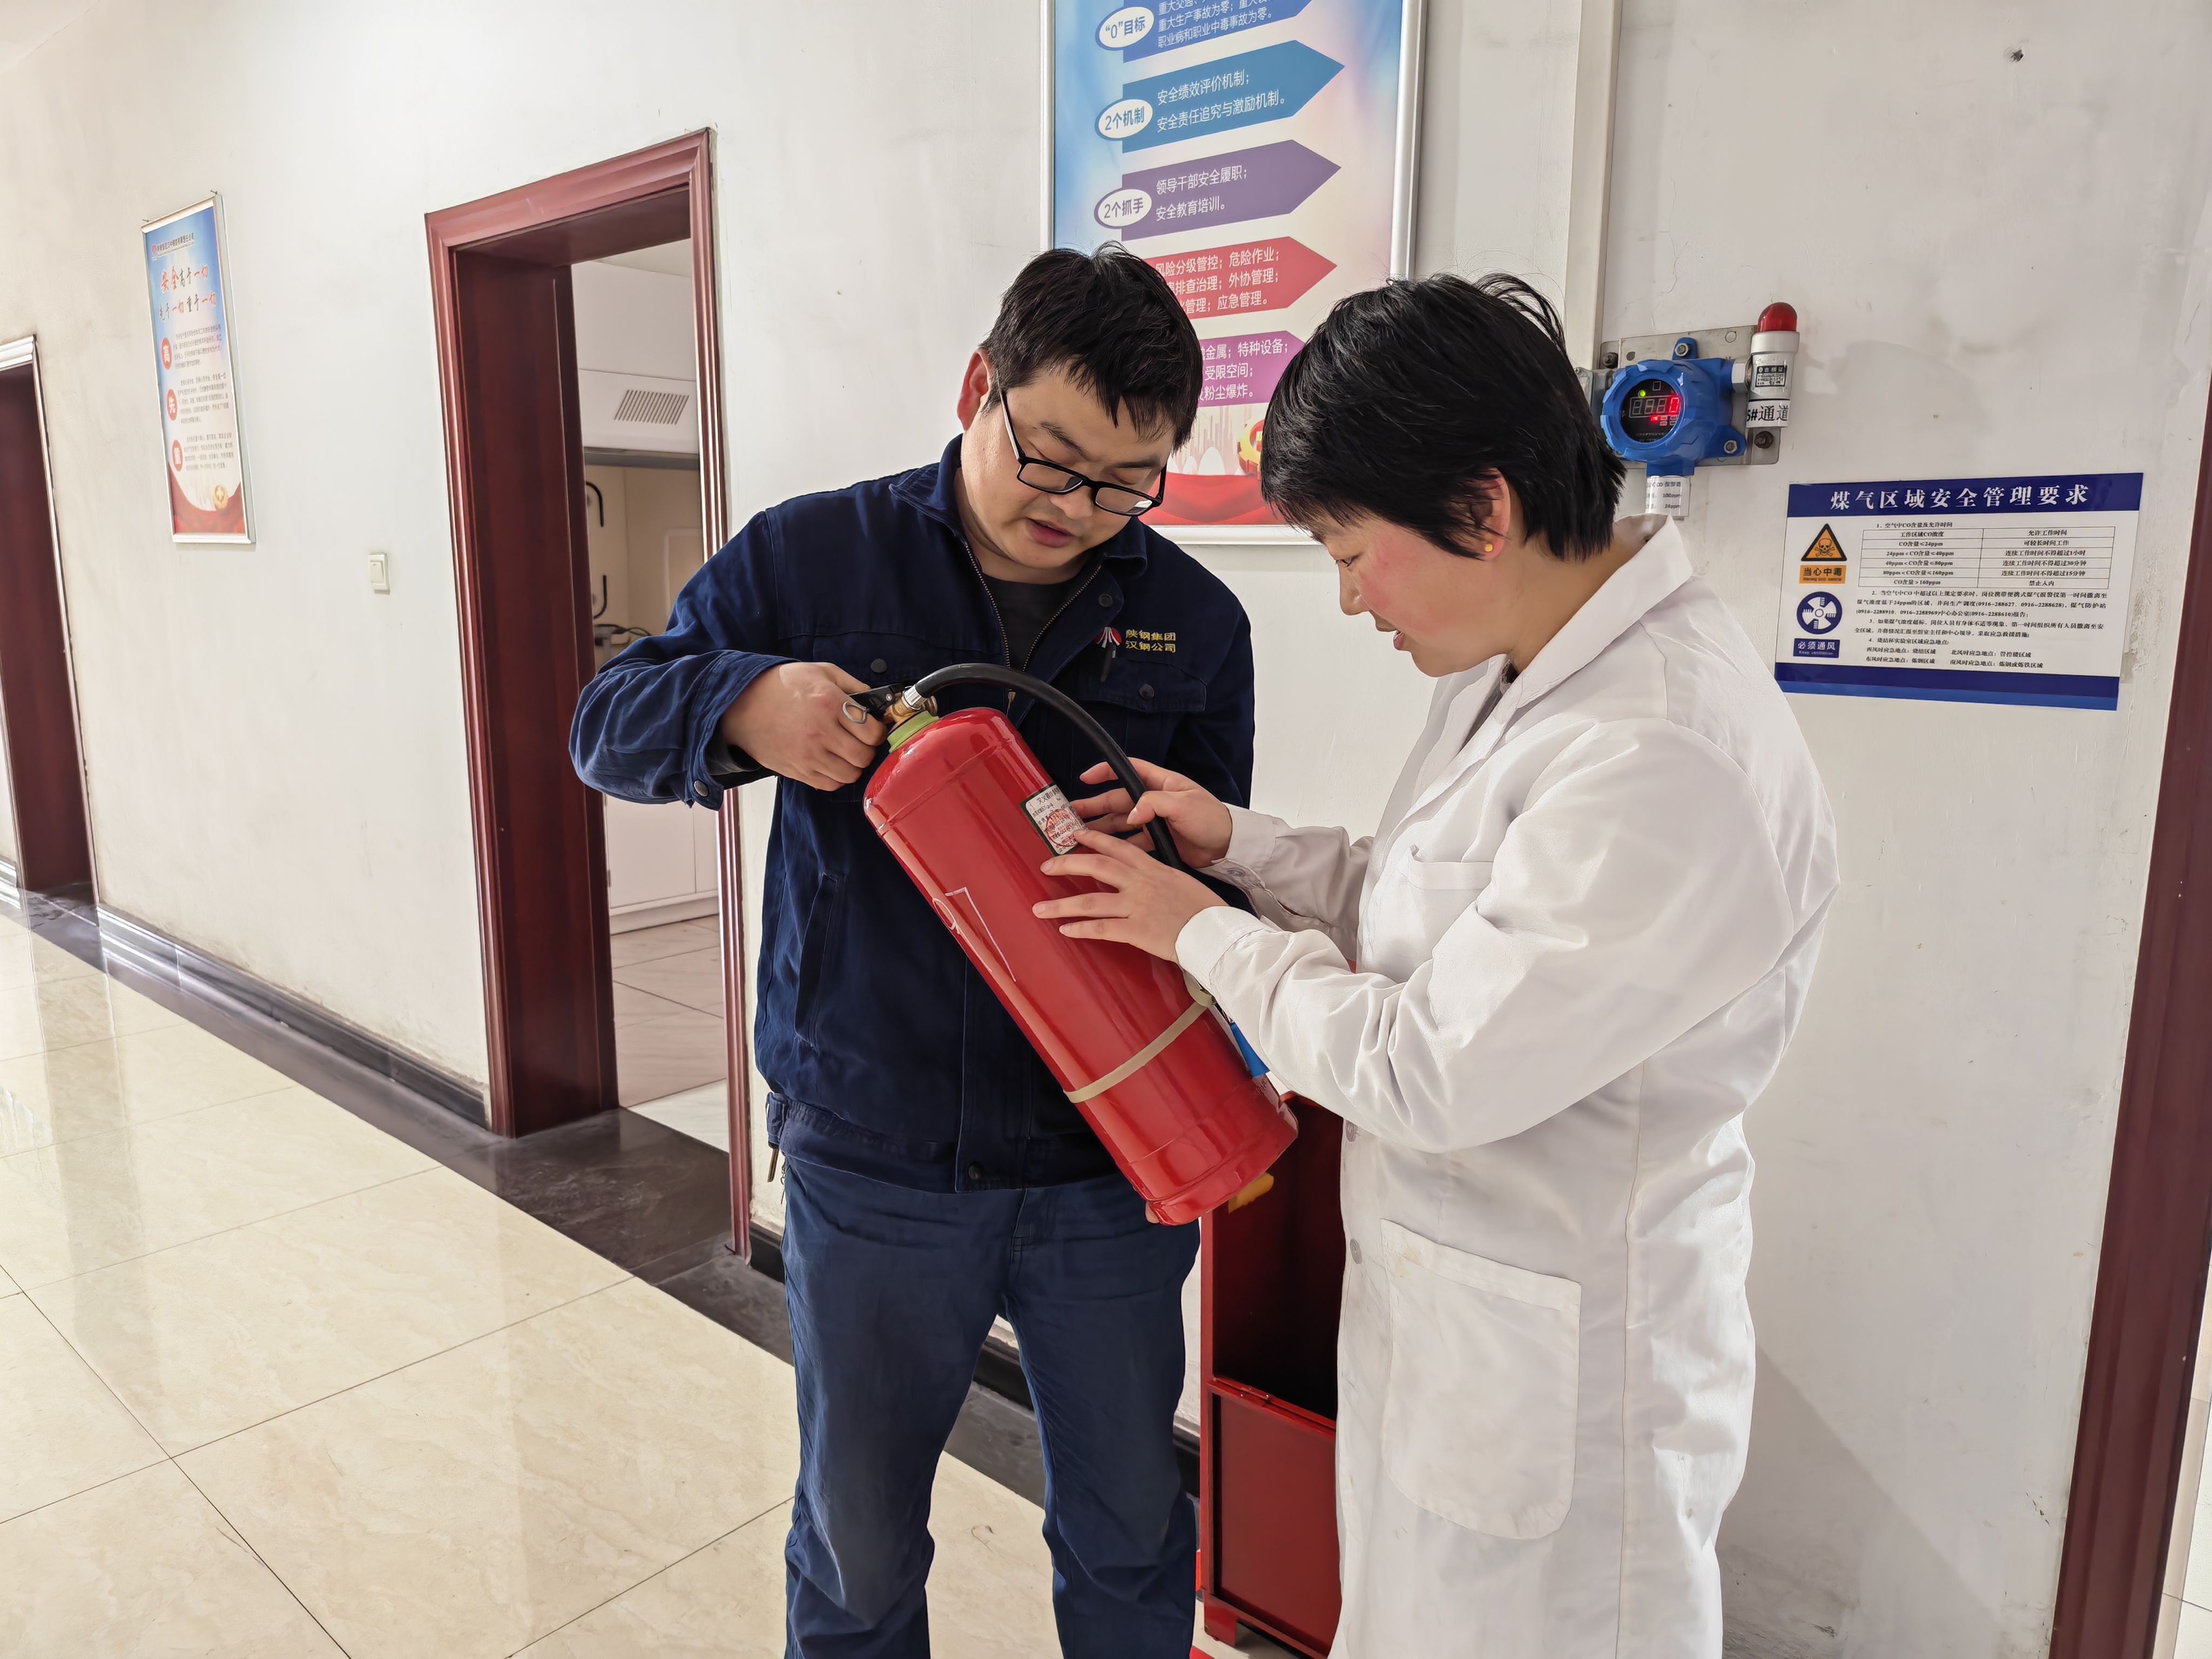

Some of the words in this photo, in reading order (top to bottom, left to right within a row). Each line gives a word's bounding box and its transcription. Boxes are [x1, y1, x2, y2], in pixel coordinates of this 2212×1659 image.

[1158, 6, 1272, 48] 职业病和职业中毒事故为零。
[1157, 69, 1249, 105] 安全绩效评价机制；
[1105, 106, 1145, 131] 2个机制
[1157, 89, 1285, 132] 安全责任追究与激励机制。
[1156, 165, 1247, 195] 领导干部安全履职；
[1104, 197, 1144, 219] 2个抓手
[1156, 196, 1225, 221] 安全教育培训。
[1830, 484, 2089, 510] 煤气区域安全管理要求
[1125, 629, 1176, 641] 陕钢集团
[1125, 640, 1176, 653] 汉钢公司
[1798, 640, 1836, 651] 必须通风
